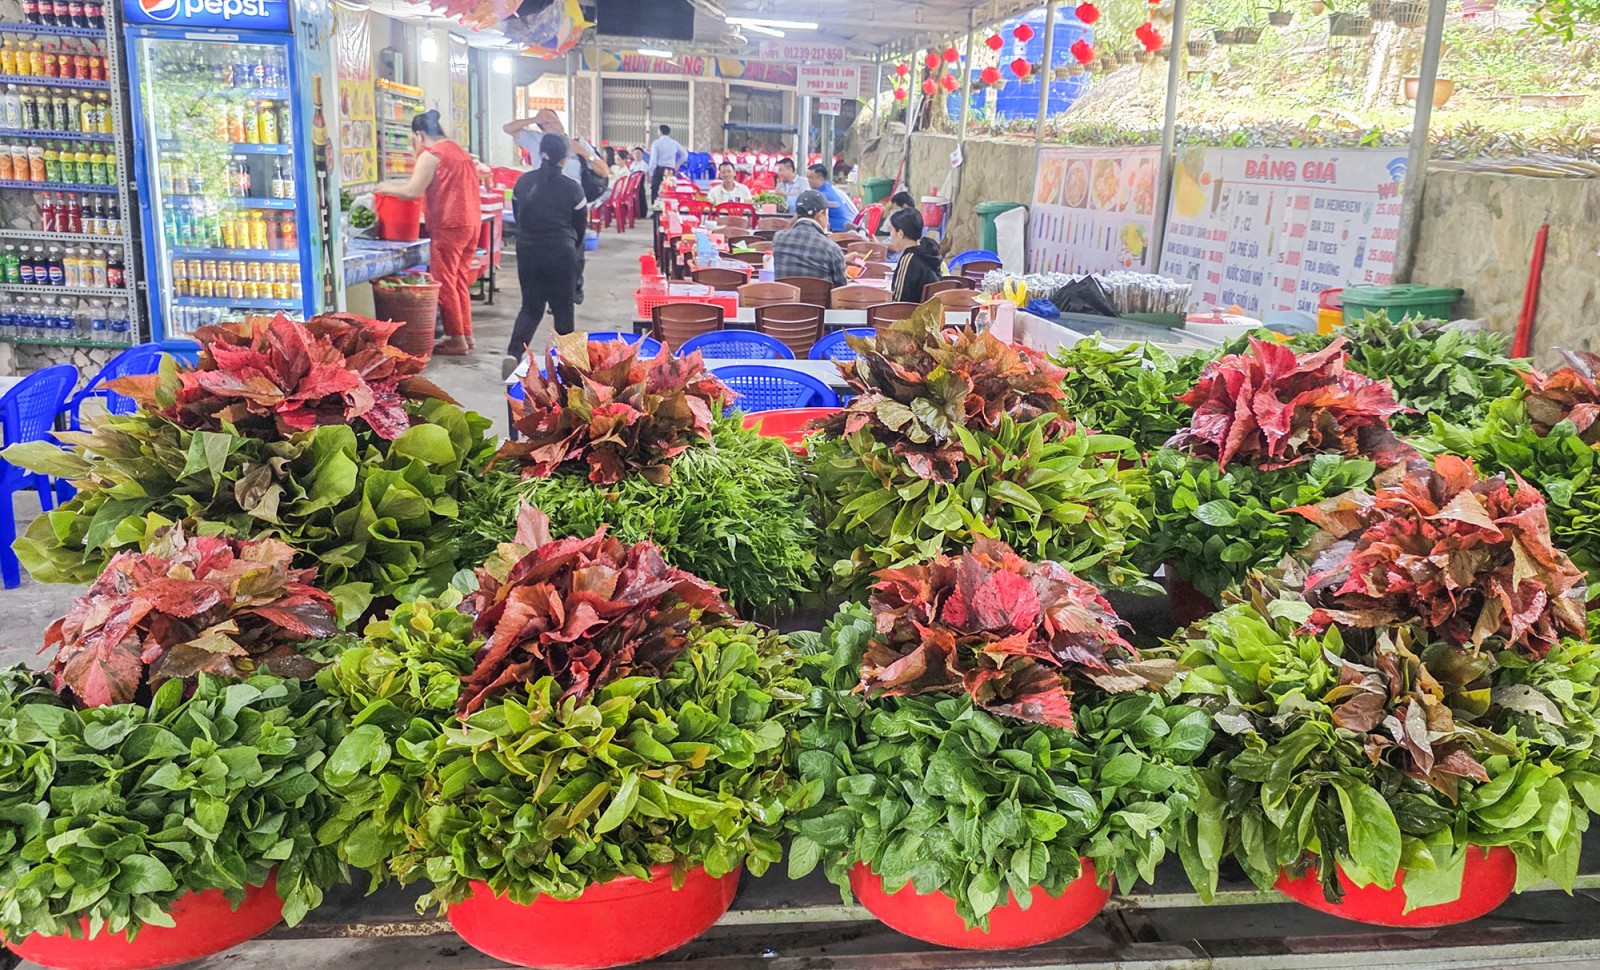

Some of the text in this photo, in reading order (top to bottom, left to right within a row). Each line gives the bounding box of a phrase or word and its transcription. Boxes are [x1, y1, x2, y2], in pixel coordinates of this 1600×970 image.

[1244, 154, 1338, 184] BẢNG GIÁ
[1322, 221, 1336, 234] 333
